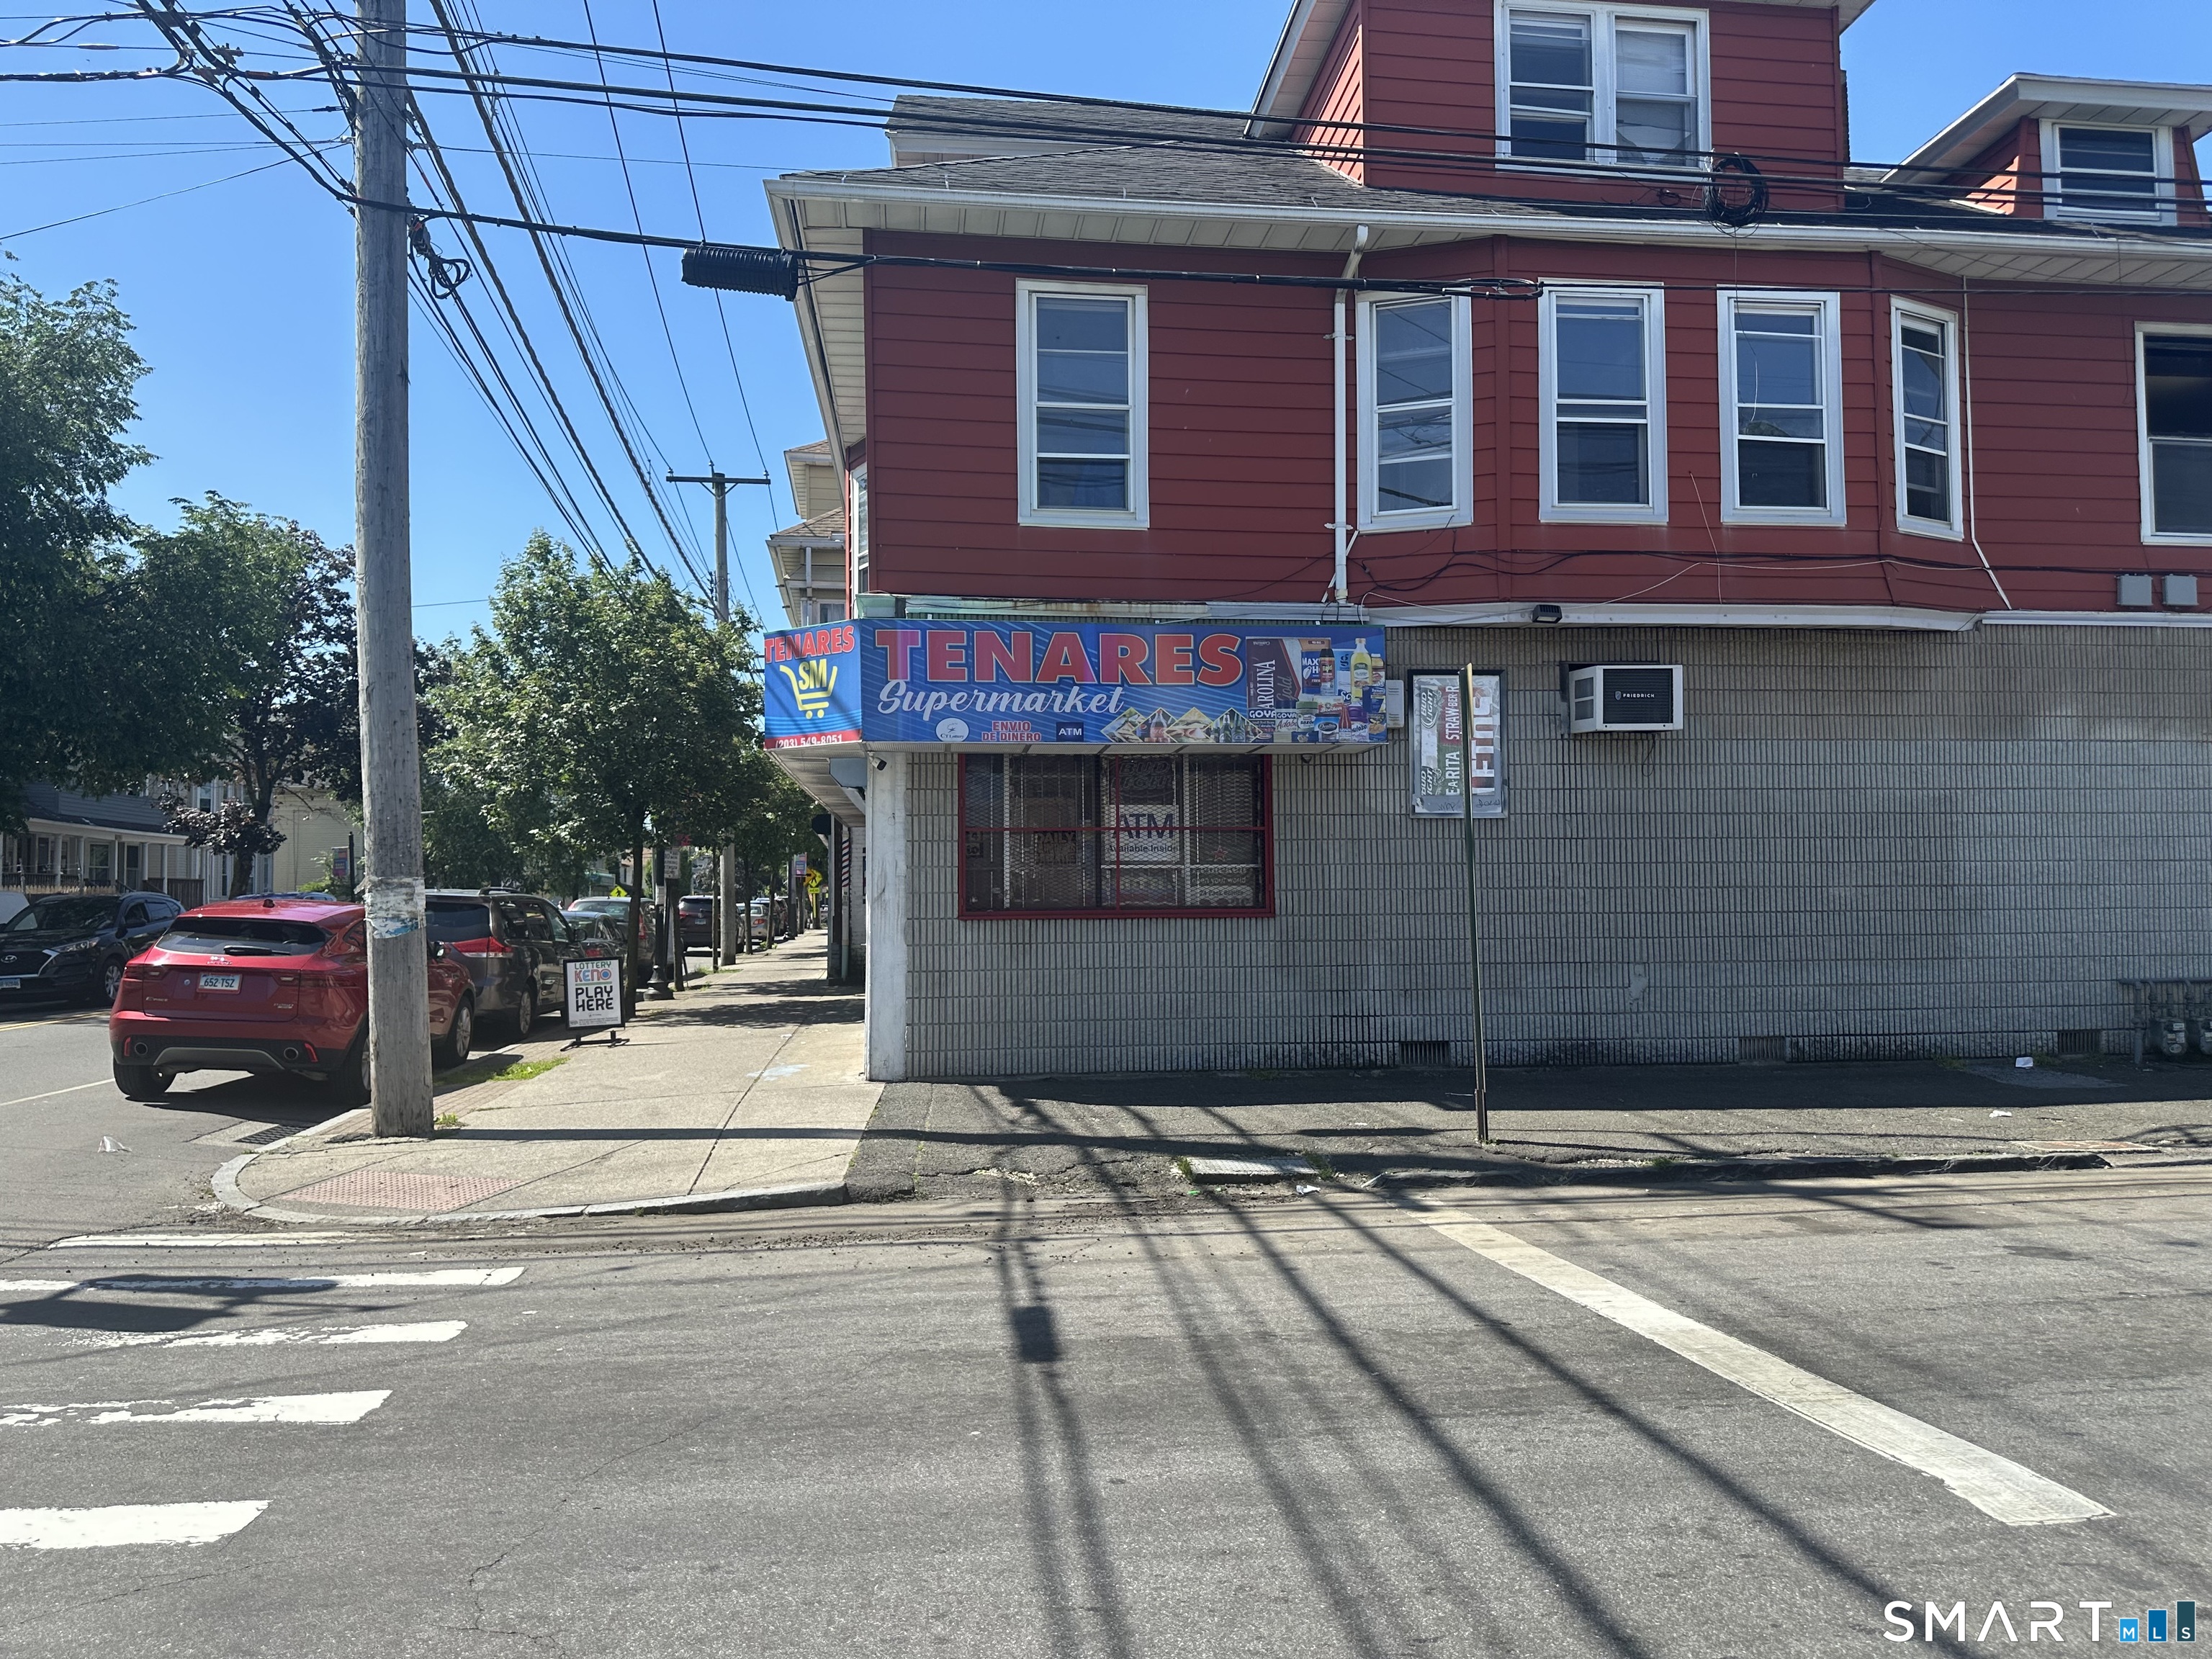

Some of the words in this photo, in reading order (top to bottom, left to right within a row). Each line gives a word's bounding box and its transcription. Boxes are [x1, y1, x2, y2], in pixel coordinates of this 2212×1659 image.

[765, 625, 855, 664] TENARES
[875, 629, 1244, 685] TENARES
[798, 658, 827, 691] SM
[1253, 660, 1275, 709] AROLINA
[878, 679, 1125, 721] Supermarket
[992, 721, 1031, 732] ENVIO
[775, 738, 798, 749] (203)
[981, 732, 997, 742] DE
[999, 732, 1041, 742] DINERO
[1111, 813, 1174, 839] ATM
[575, 961, 611, 970] LOTTERY
[575, 968, 611, 982] KENO
[575, 985, 613, 999] PLAY
[576, 997, 613, 1012] HERE
